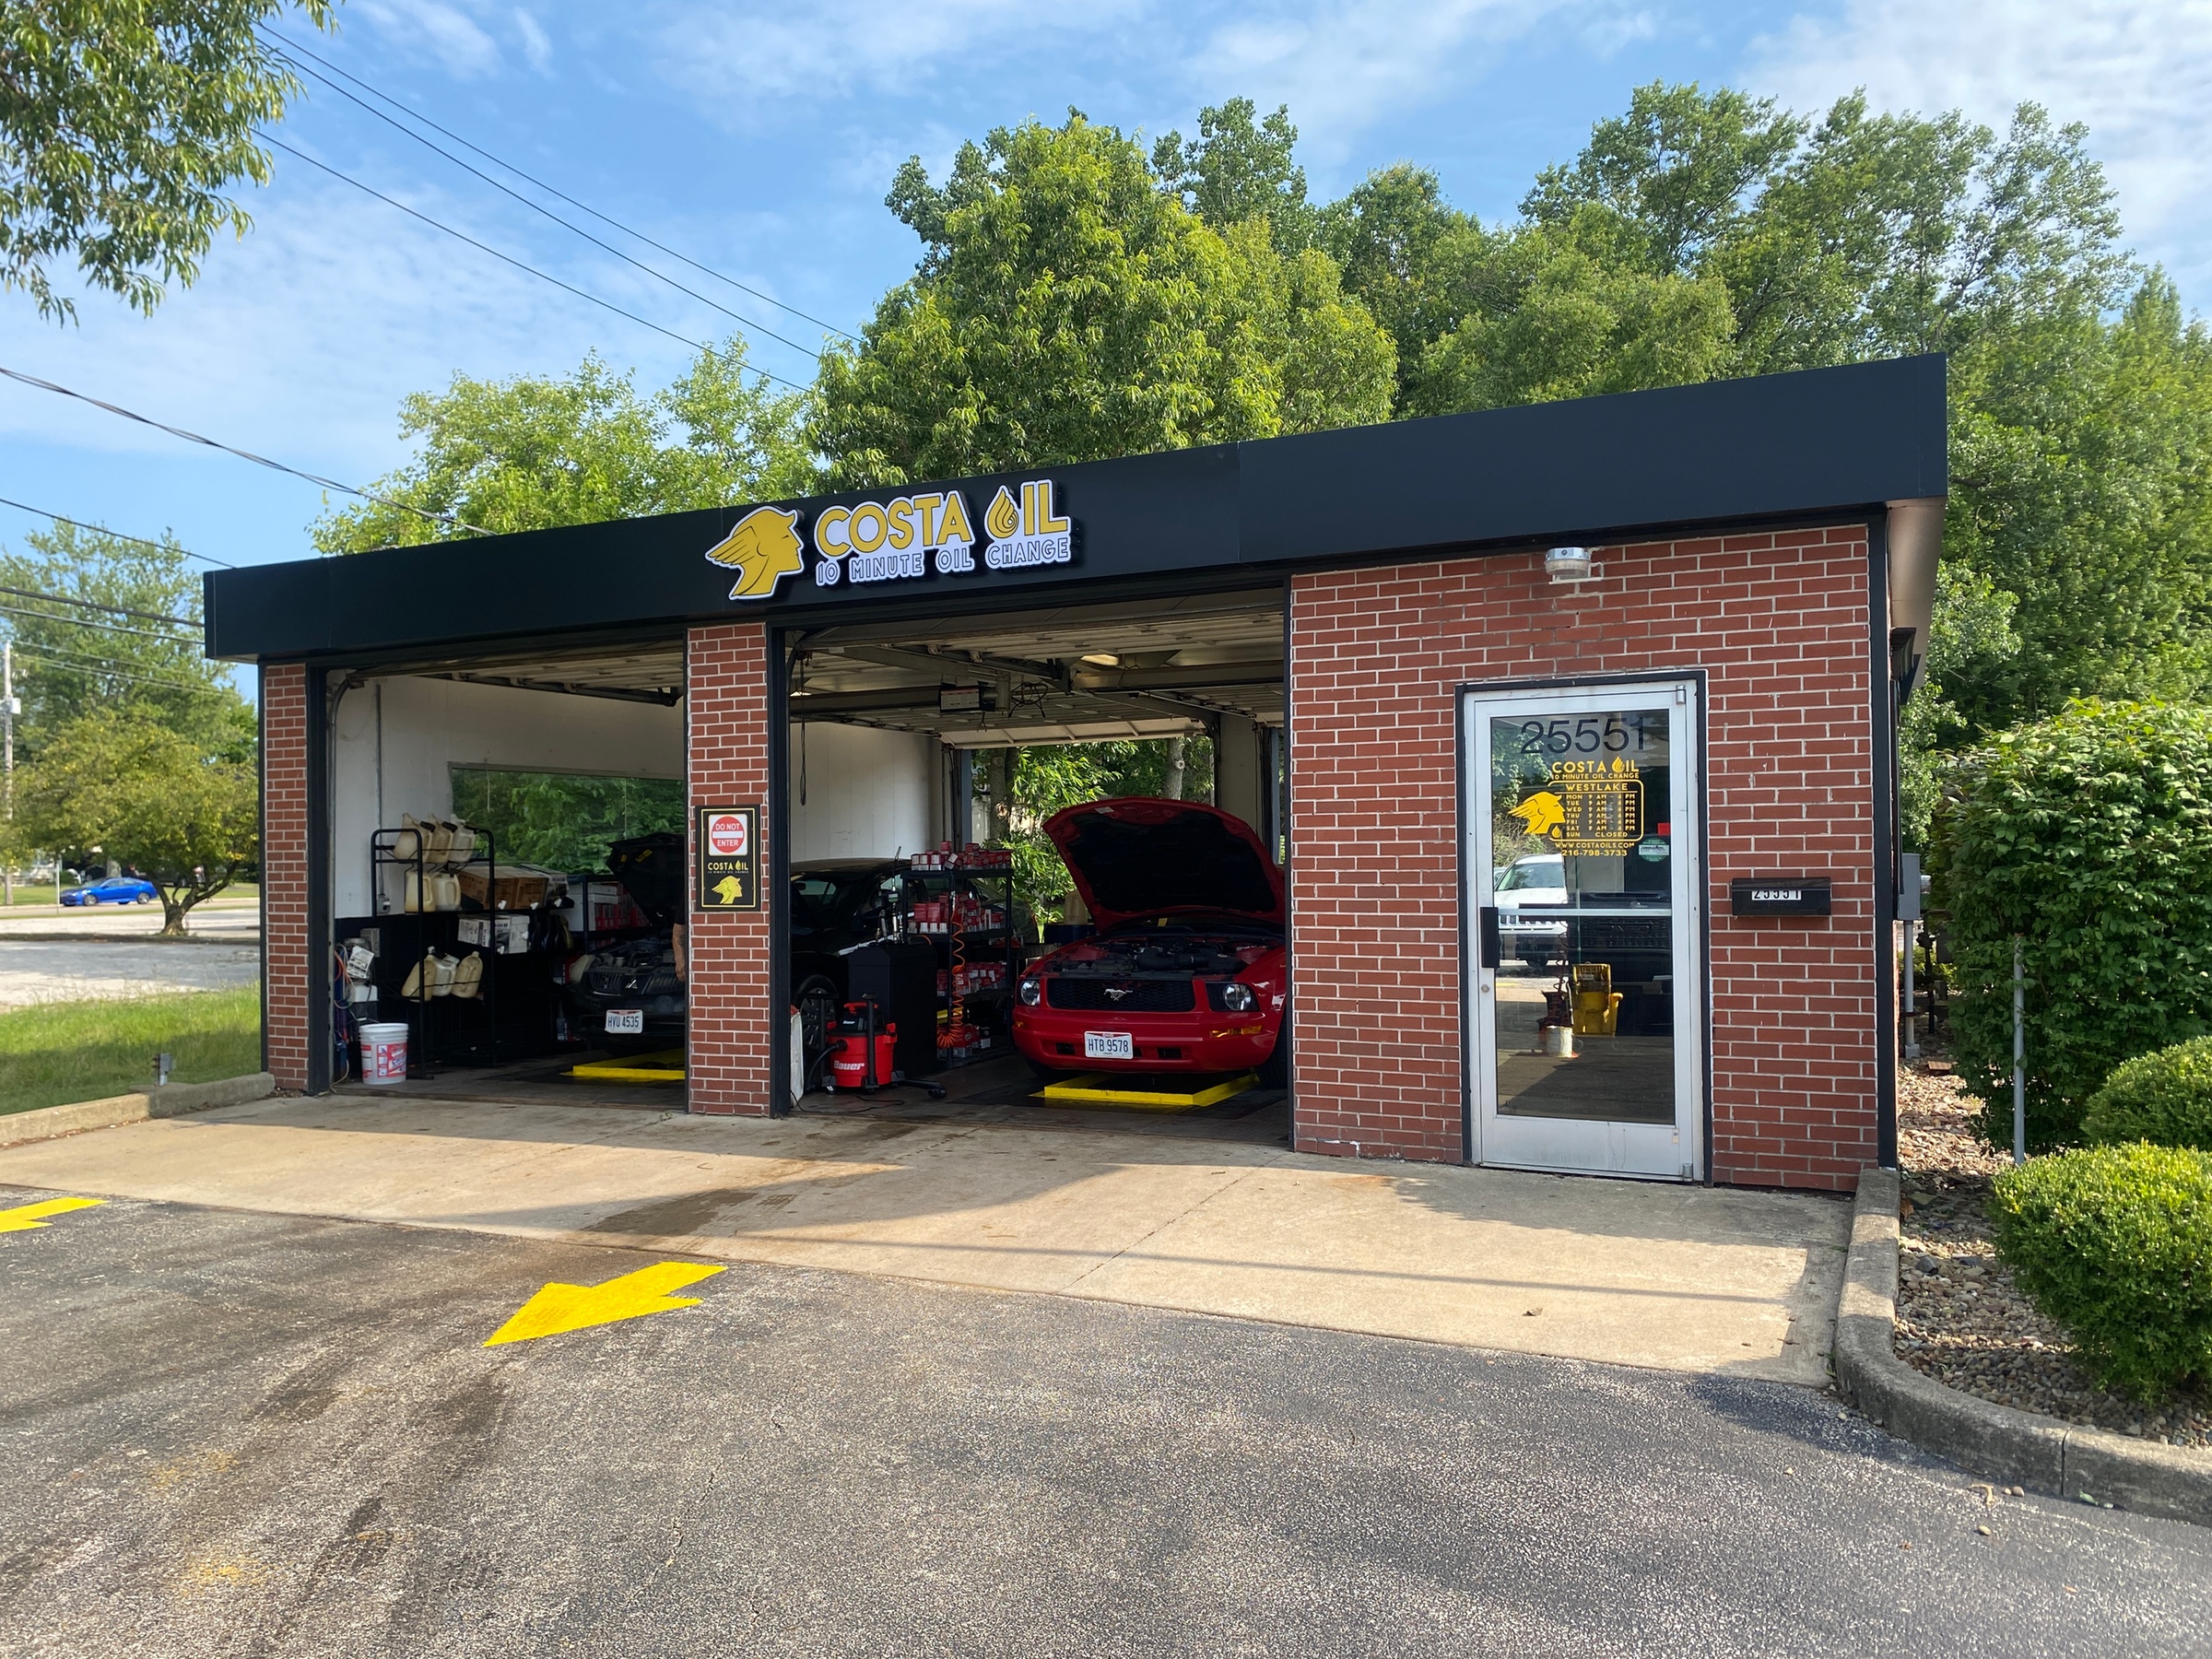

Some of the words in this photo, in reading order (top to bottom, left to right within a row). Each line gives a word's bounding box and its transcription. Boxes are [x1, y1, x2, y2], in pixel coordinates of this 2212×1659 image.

[817, 492, 972, 557] COSTA
[818, 563, 837, 582] 10
[852, 553, 923, 580] MINUTE
[937, 547, 972, 571] OIL
[987, 536, 1070, 564] CHANGE
[1521, 716, 1644, 754] 25551
[1552, 760, 1606, 773] COSTA
[1565, 782, 1629, 791] WESTLAKE
[707, 862, 734, 871] COSTA
[621, 1016, 640, 1028] 4535
[1088, 1038, 1105, 1052] HTB
[1107, 1039, 1129, 1053] 9578
[834, 1060, 865, 1070] Bauer
